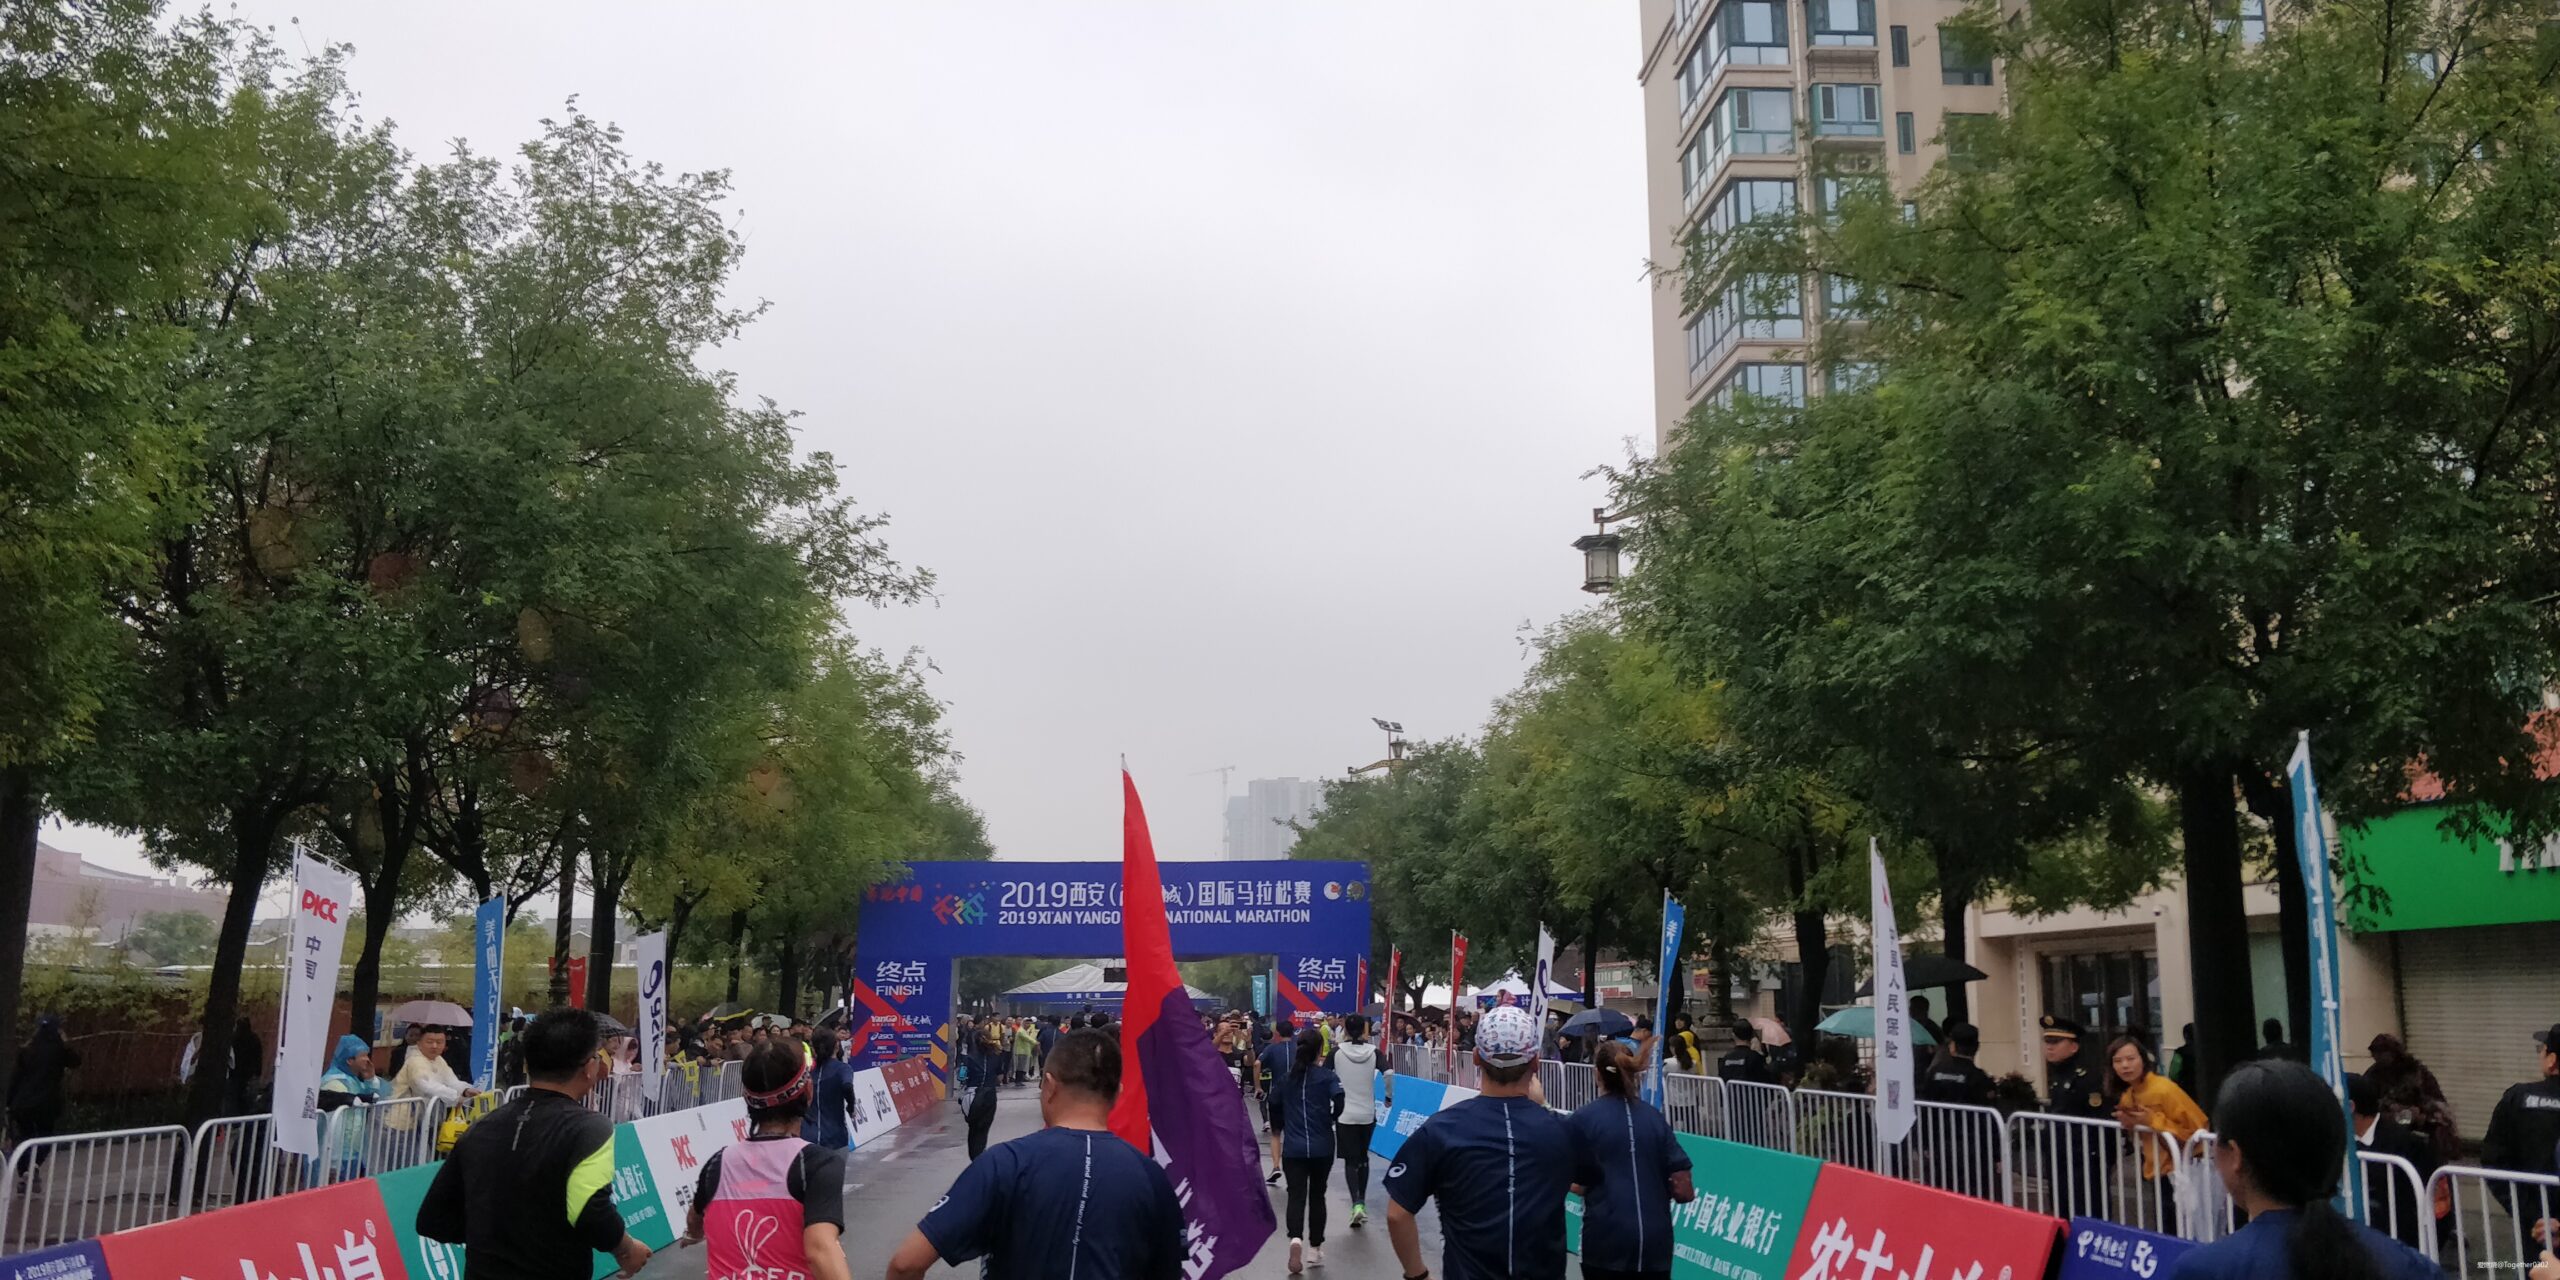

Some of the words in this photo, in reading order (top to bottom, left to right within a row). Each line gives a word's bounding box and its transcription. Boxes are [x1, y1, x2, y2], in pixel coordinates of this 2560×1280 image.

[301, 889, 338, 924] PICC
[1075, 910, 1121, 925] YANGO
[1236, 908, 1311, 924] MARATHON
[876, 960, 928, 982] 终点
[1298, 957, 1347, 980] 终点
[875, 985, 923, 996] FINISH
[1298, 981, 1343, 993] FINISH
[2131, 1240, 2158, 1279] 5G
